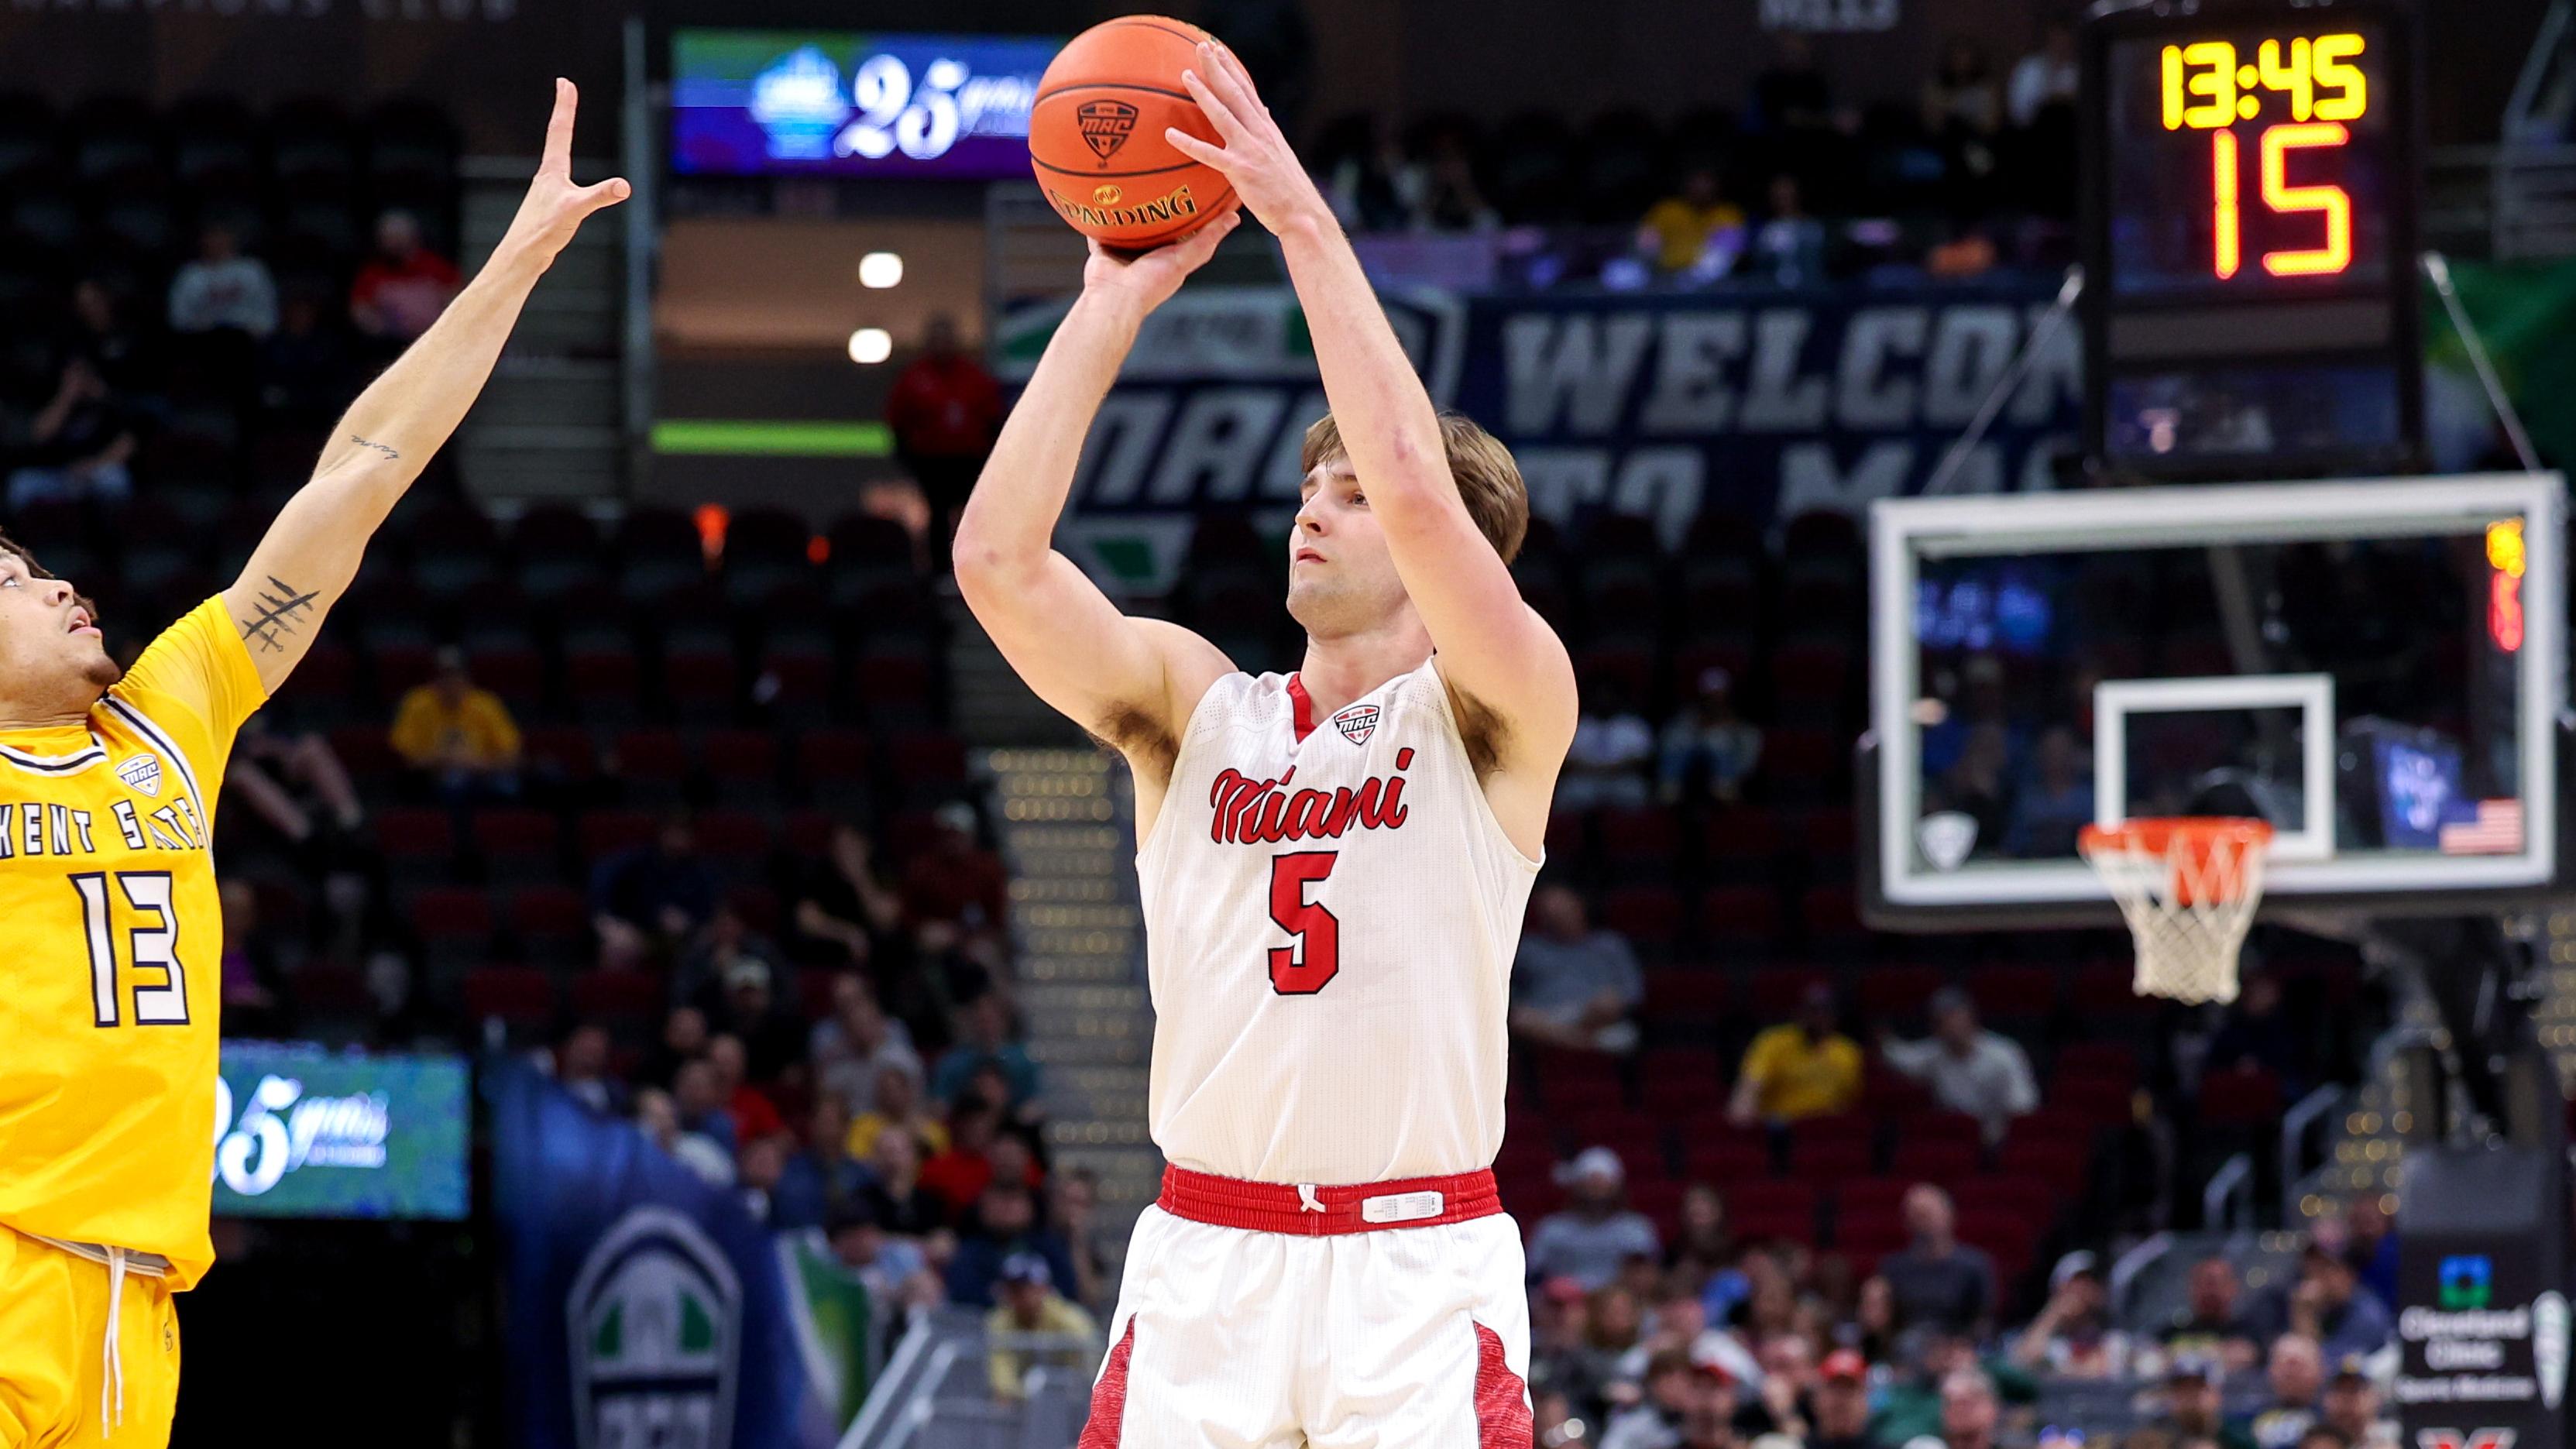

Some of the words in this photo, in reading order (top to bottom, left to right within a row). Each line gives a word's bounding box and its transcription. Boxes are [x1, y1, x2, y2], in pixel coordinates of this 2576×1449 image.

[2162, 34, 2367, 130] 13:45
[1082, 116, 1134, 135] MAC
[1049, 184, 1197, 227] SPALDING
[2213, 122, 2351, 280] 15
[1337, 714, 1378, 733] MAC
[121, 761, 159, 785] MAC
[1210, 747, 1415, 844] Miami
[0, 802, 95, 860] KENT
[67, 871, 191, 1028] 13
[1268, 850, 1339, 995] 5
